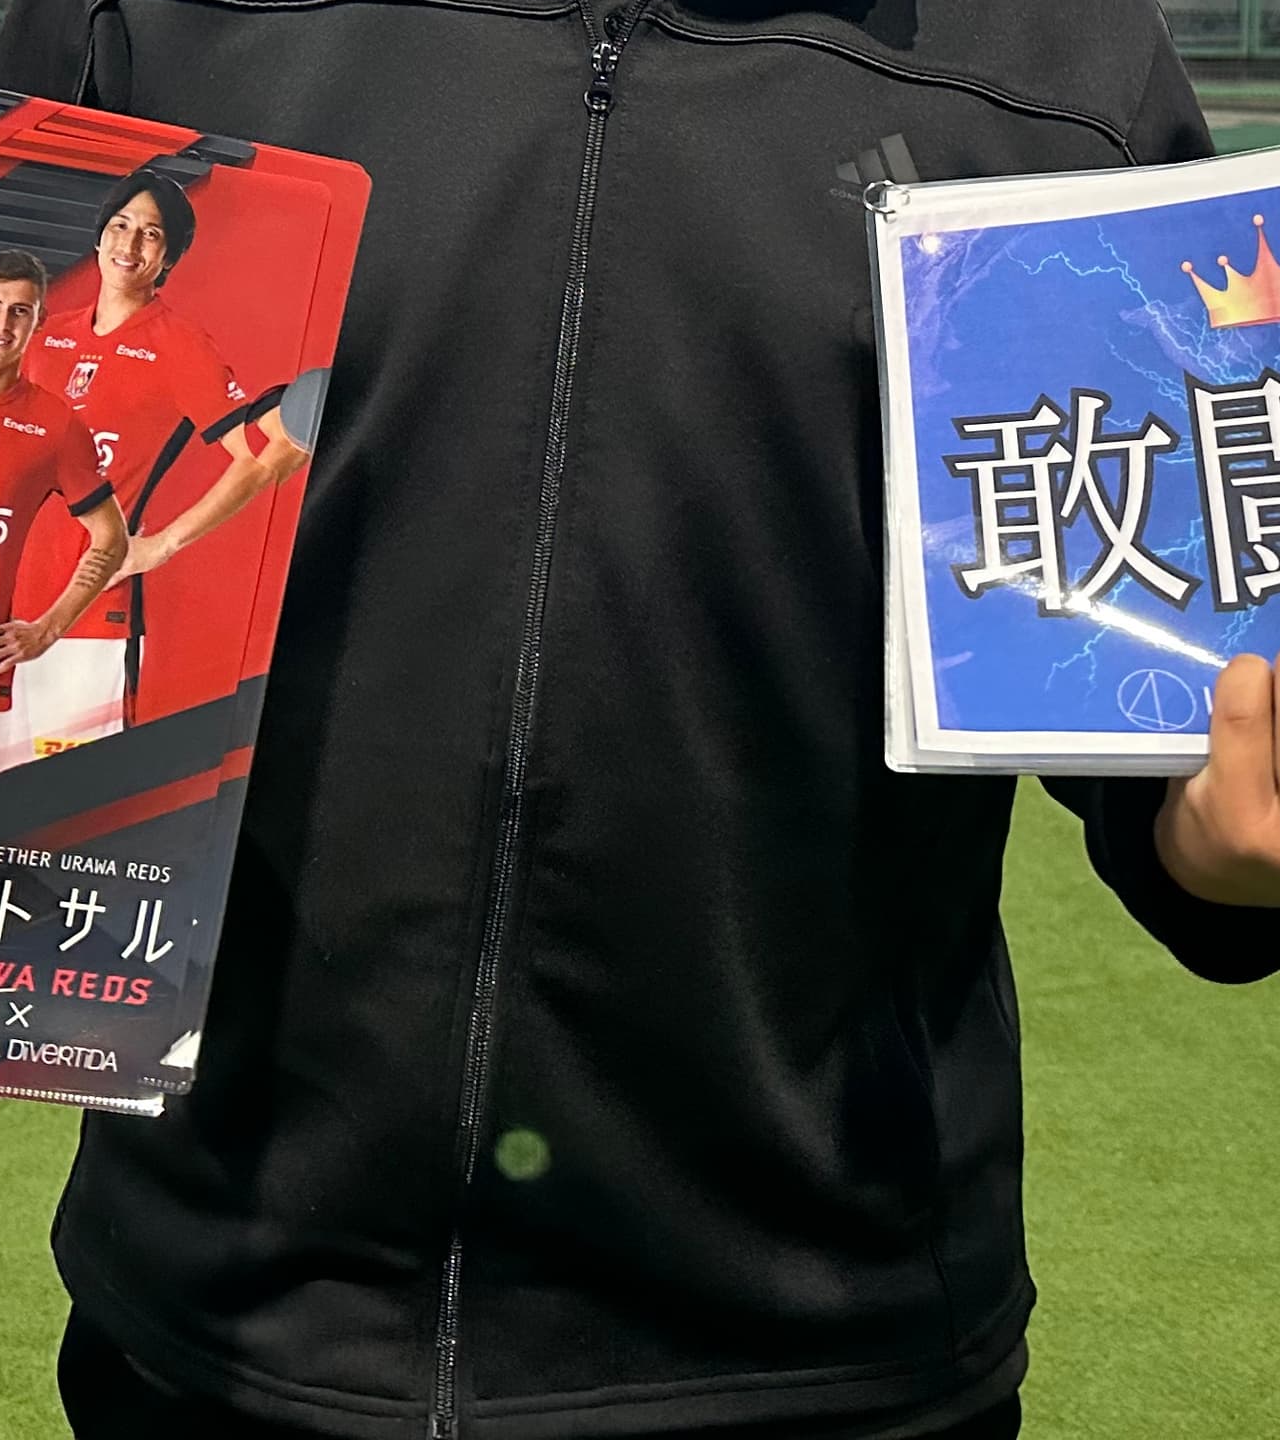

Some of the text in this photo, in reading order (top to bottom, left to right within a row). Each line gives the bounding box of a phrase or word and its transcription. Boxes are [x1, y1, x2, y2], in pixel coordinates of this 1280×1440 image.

[60, 854, 117, 877] URAWA
[125, 862, 172, 883] REDS
[50, 967, 154, 1006] REDS
